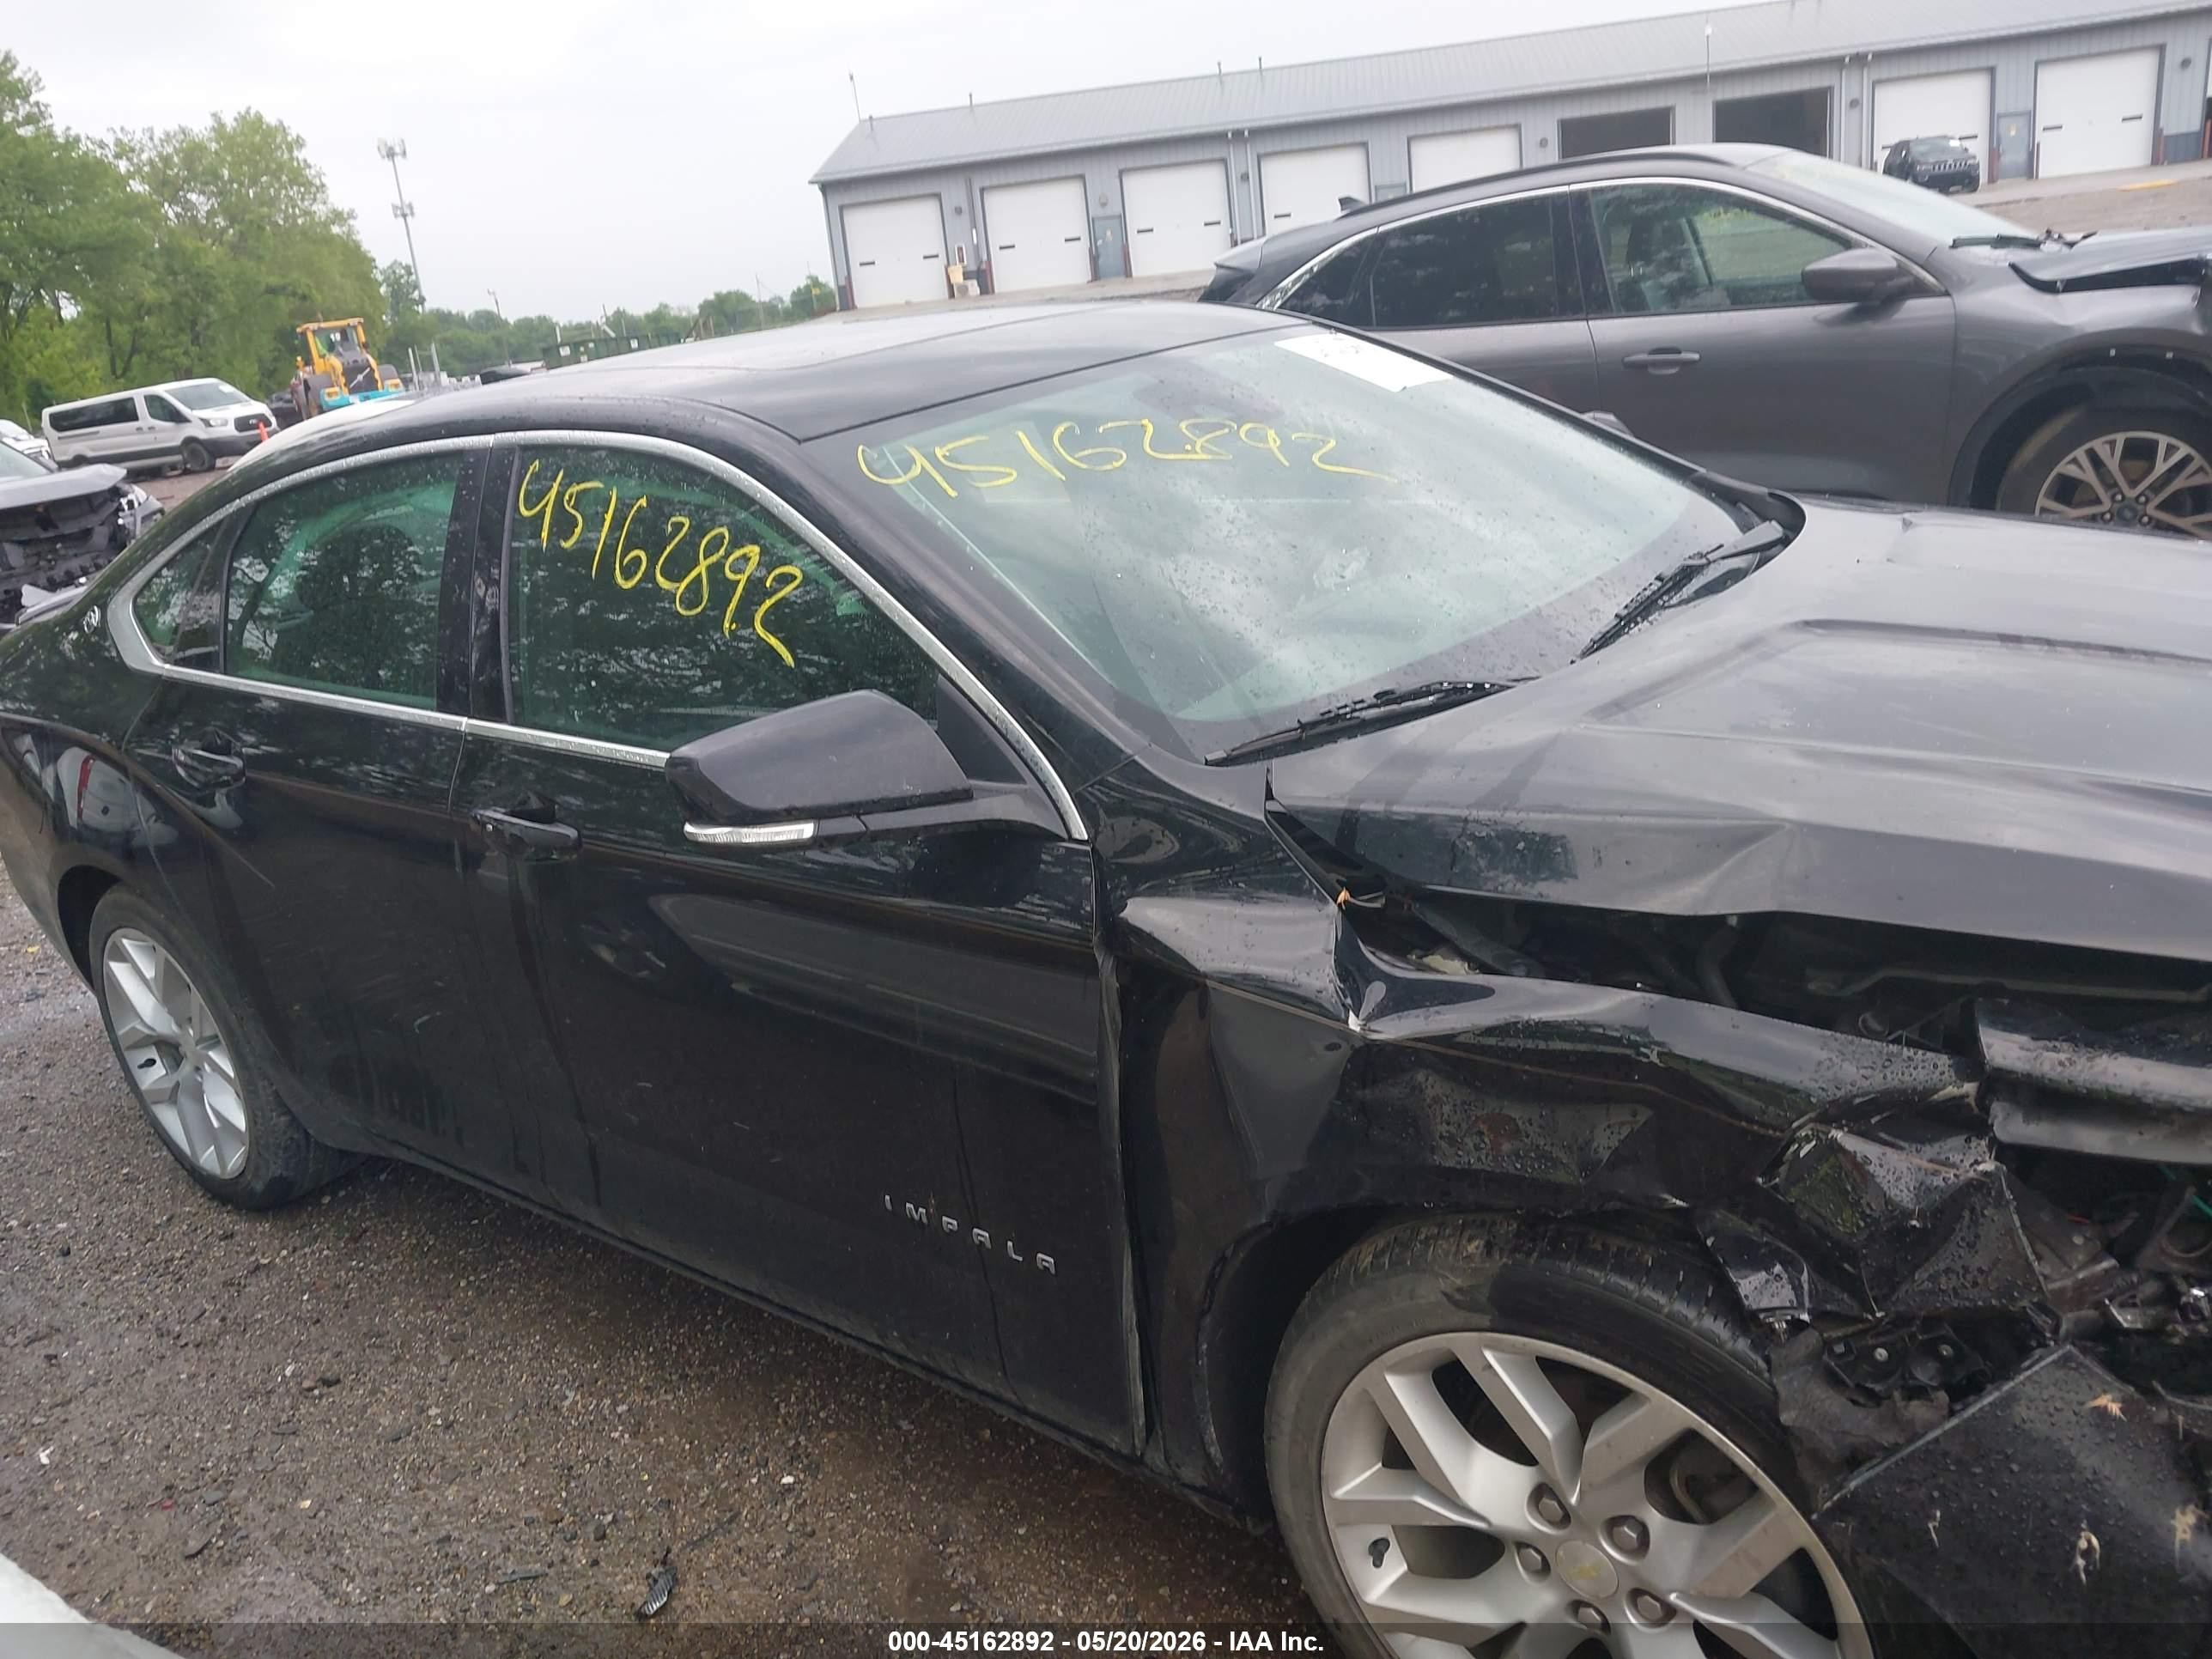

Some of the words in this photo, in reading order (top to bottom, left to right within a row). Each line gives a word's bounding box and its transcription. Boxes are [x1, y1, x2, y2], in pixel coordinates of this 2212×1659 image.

[858, 418, 1398, 498] 45162892
[518, 459, 804, 668] 45162892
[884, 1194, 1056, 1275] IMPALA
